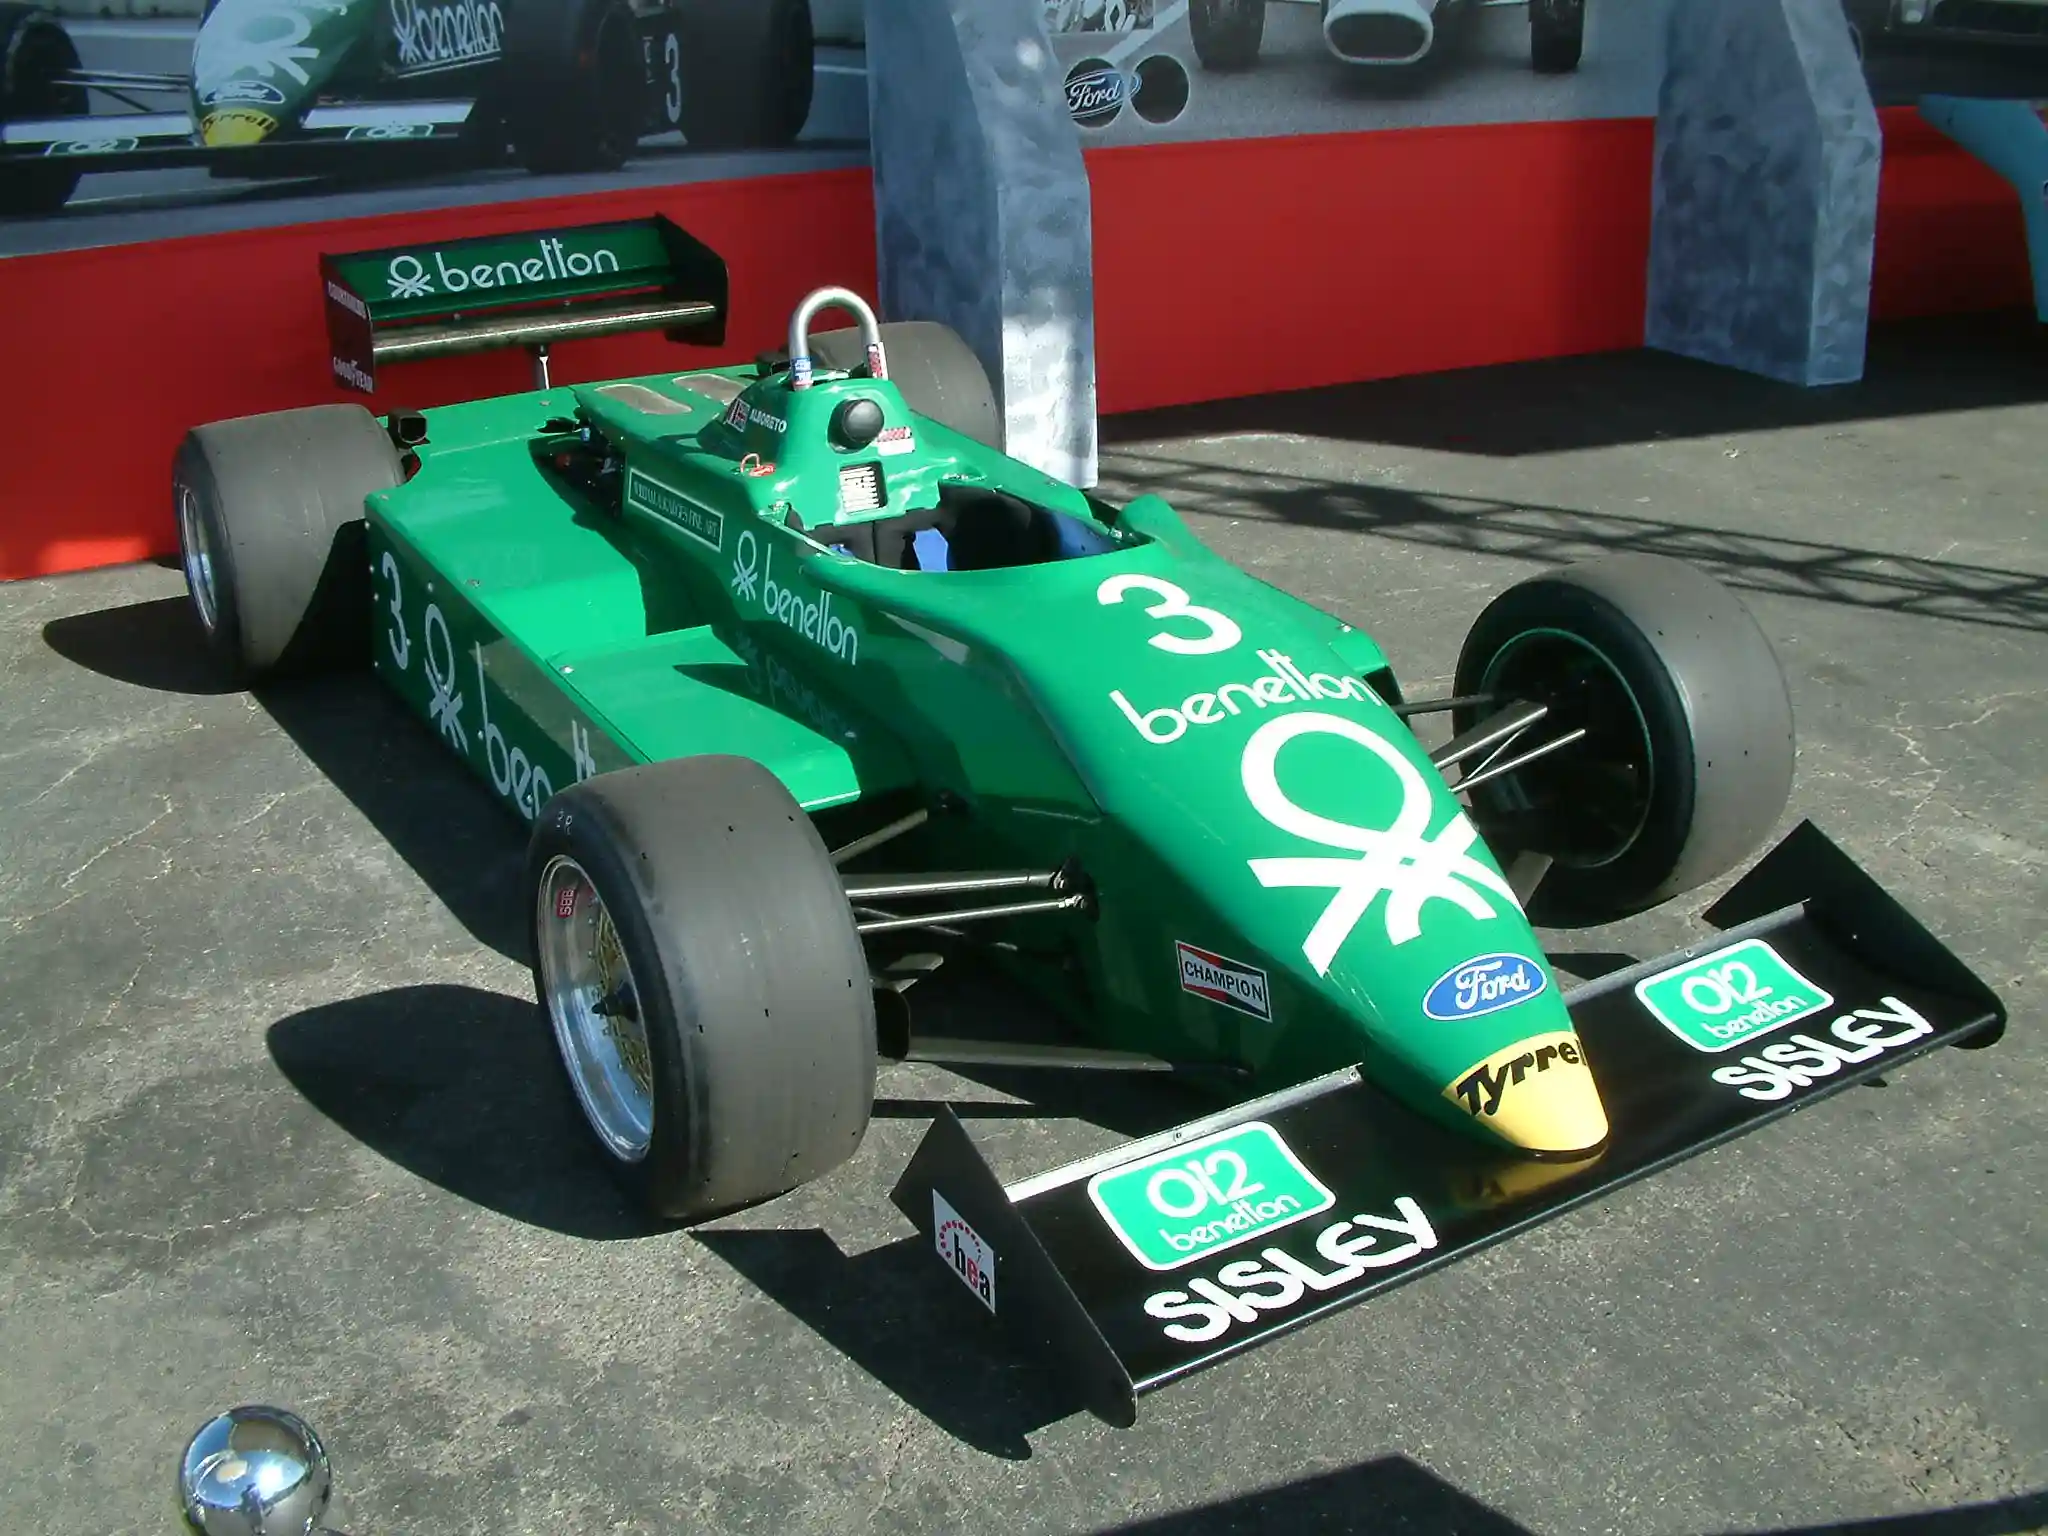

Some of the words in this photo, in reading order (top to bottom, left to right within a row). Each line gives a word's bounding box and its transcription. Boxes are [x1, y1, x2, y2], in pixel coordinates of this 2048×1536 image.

[665, 33, 681, 123] 3
[1067, 77, 1123, 111] Ford
[435, 238, 619, 292] benetton
[382, 551, 408, 670] 3
[763, 543, 858, 666] benetton
[1096, 573, 1243, 655] 3
[1108, 648, 1382, 744] benetton
[1184, 961, 1263, 1001] CHAMPION
[1454, 959, 1531, 1010] Ford
[1699, 994, 1809, 1040] benetton
[1711, 996, 1935, 1101] SISLEY
[1158, 1193, 1302, 1252] benetton
[1143, 1196, 1440, 1342] SISLEY
